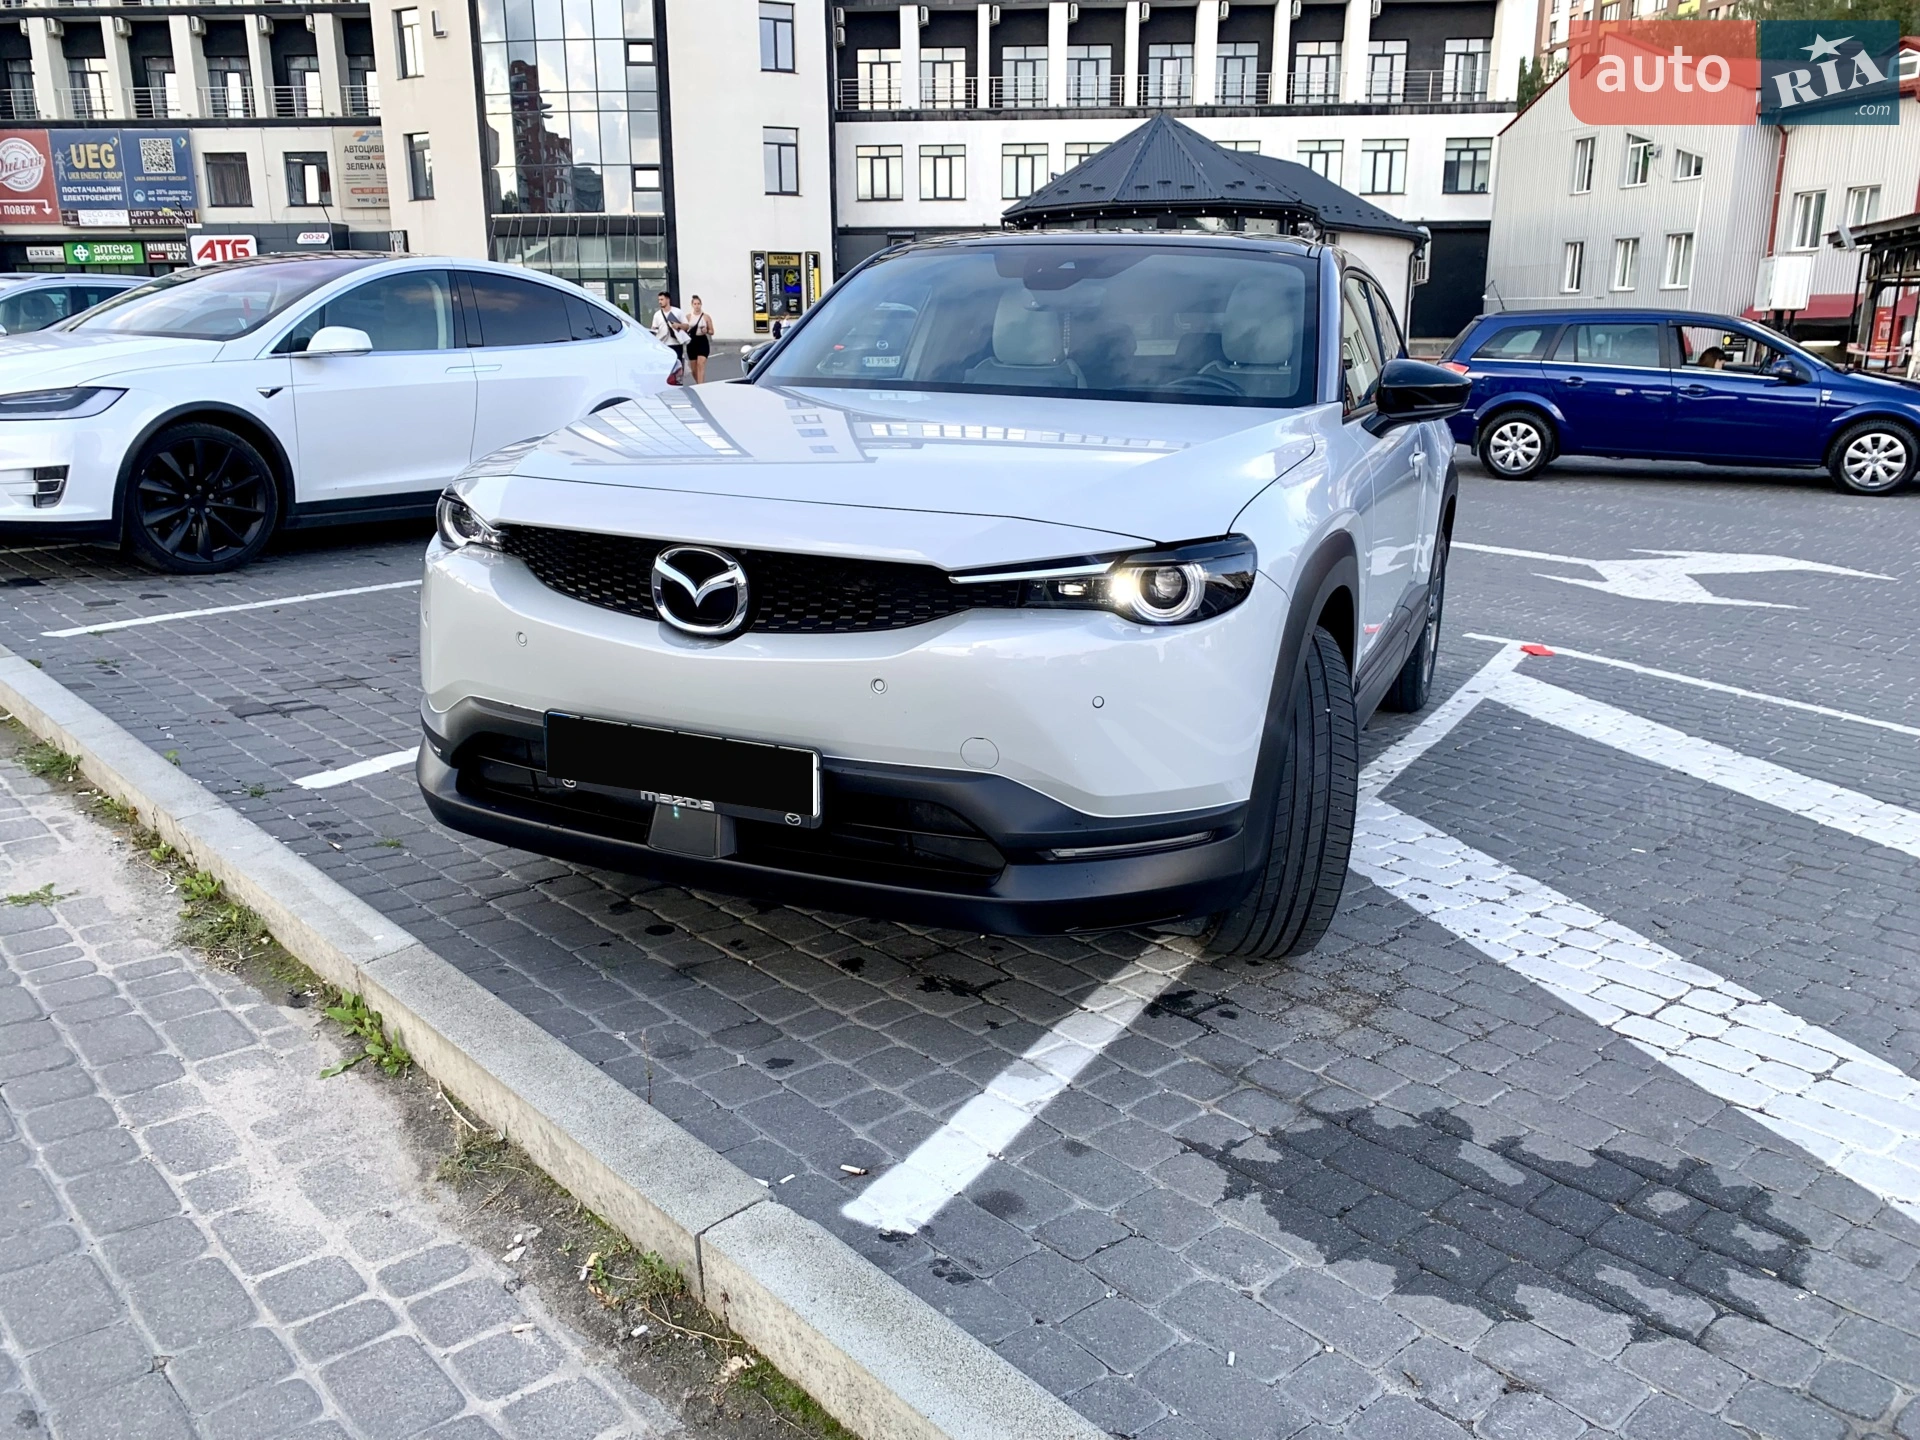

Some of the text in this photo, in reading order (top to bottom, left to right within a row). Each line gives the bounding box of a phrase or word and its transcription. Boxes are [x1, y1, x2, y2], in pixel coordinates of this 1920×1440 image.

[70, 143, 116, 169] UEG
[346, 162, 375, 171] ЗЕЛЕНА
[68, 171, 123, 179] UKR ENERGY GROUP
[63, 193, 123, 202] ЕЛЕКТРОЕНЕРГІЇ
[3, 205, 37, 215] ПОВЕРХ
[29, 249, 55, 257] ESTER
[93, 244, 134, 255] аптека
[94, 254, 121, 262] доброго
[755, 272, 763, 312] VANDAL
[640, 790, 715, 812] mazda
